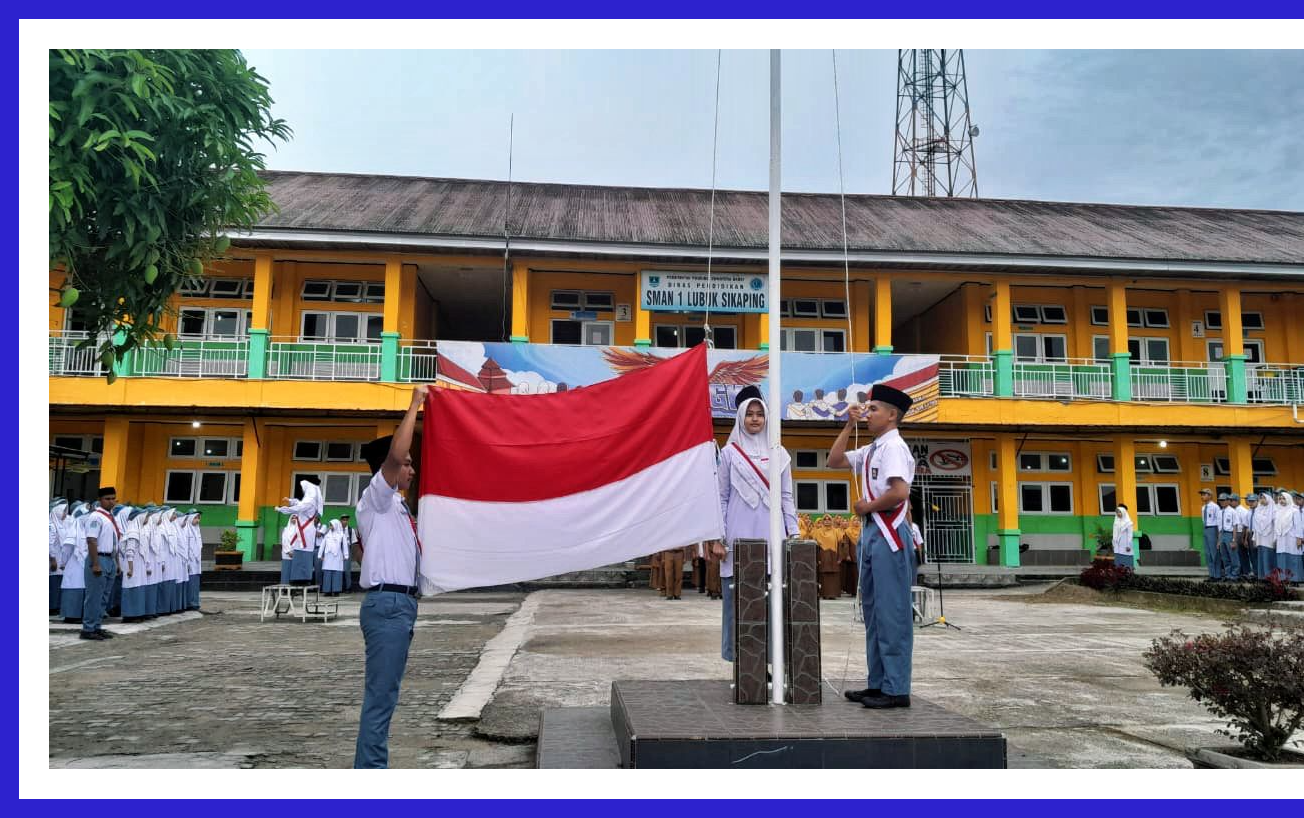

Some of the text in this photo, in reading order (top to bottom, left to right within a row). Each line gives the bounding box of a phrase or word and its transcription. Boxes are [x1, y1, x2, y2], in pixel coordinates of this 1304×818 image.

[646, 290, 765, 308] SMAN 1 LUBUK SIKAPING
